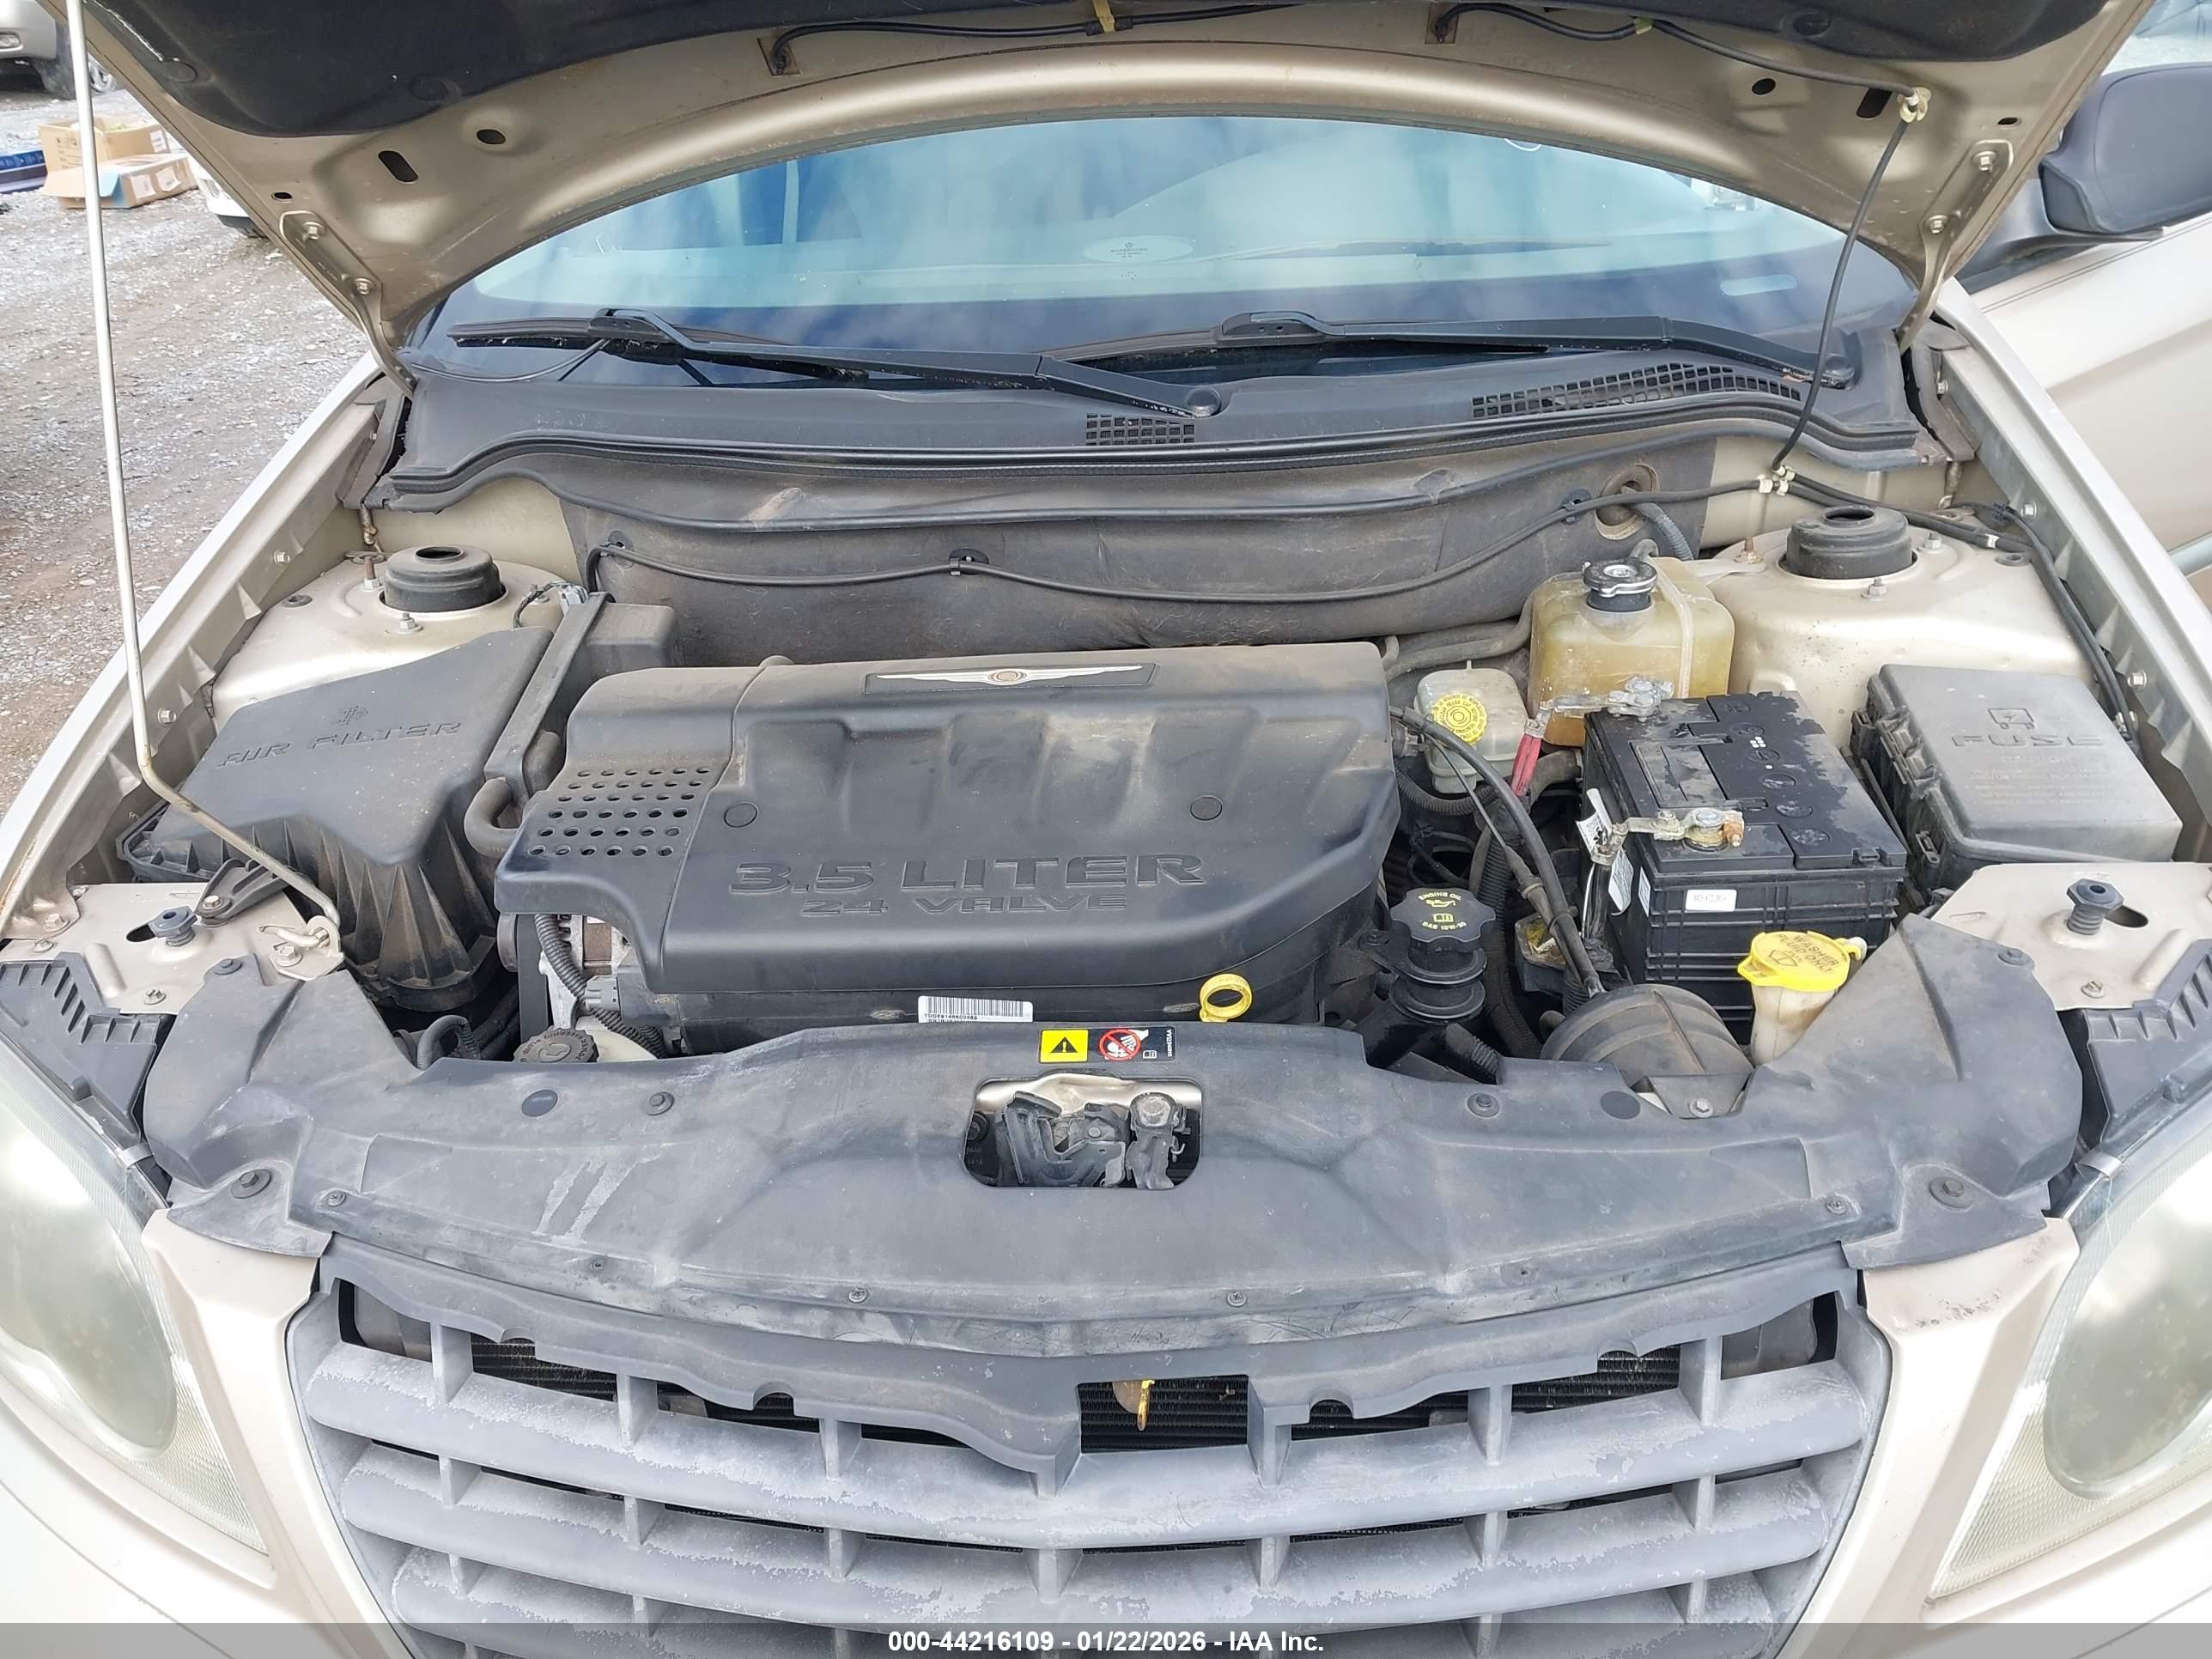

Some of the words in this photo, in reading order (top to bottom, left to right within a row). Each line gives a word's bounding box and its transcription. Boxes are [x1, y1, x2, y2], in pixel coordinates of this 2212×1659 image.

[216, 742, 290, 769] AIR
[307, 722, 462, 750] FILTER
[1951, 734, 2105, 747] FUSE
[729, 860, 876, 894] 3.5
[900, 854, 1207, 890] LITER
[799, 897, 889, 916] 24
[913, 893, 1128, 915] VALVE
[1418, 891, 1449, 900] ENGINE
[1421, 921, 1438, 930] SAE
[1778, 934, 1806, 953] FLUID
[1805, 954, 1835, 973] ONLY
[1793, 935, 1839, 965] WASHER
